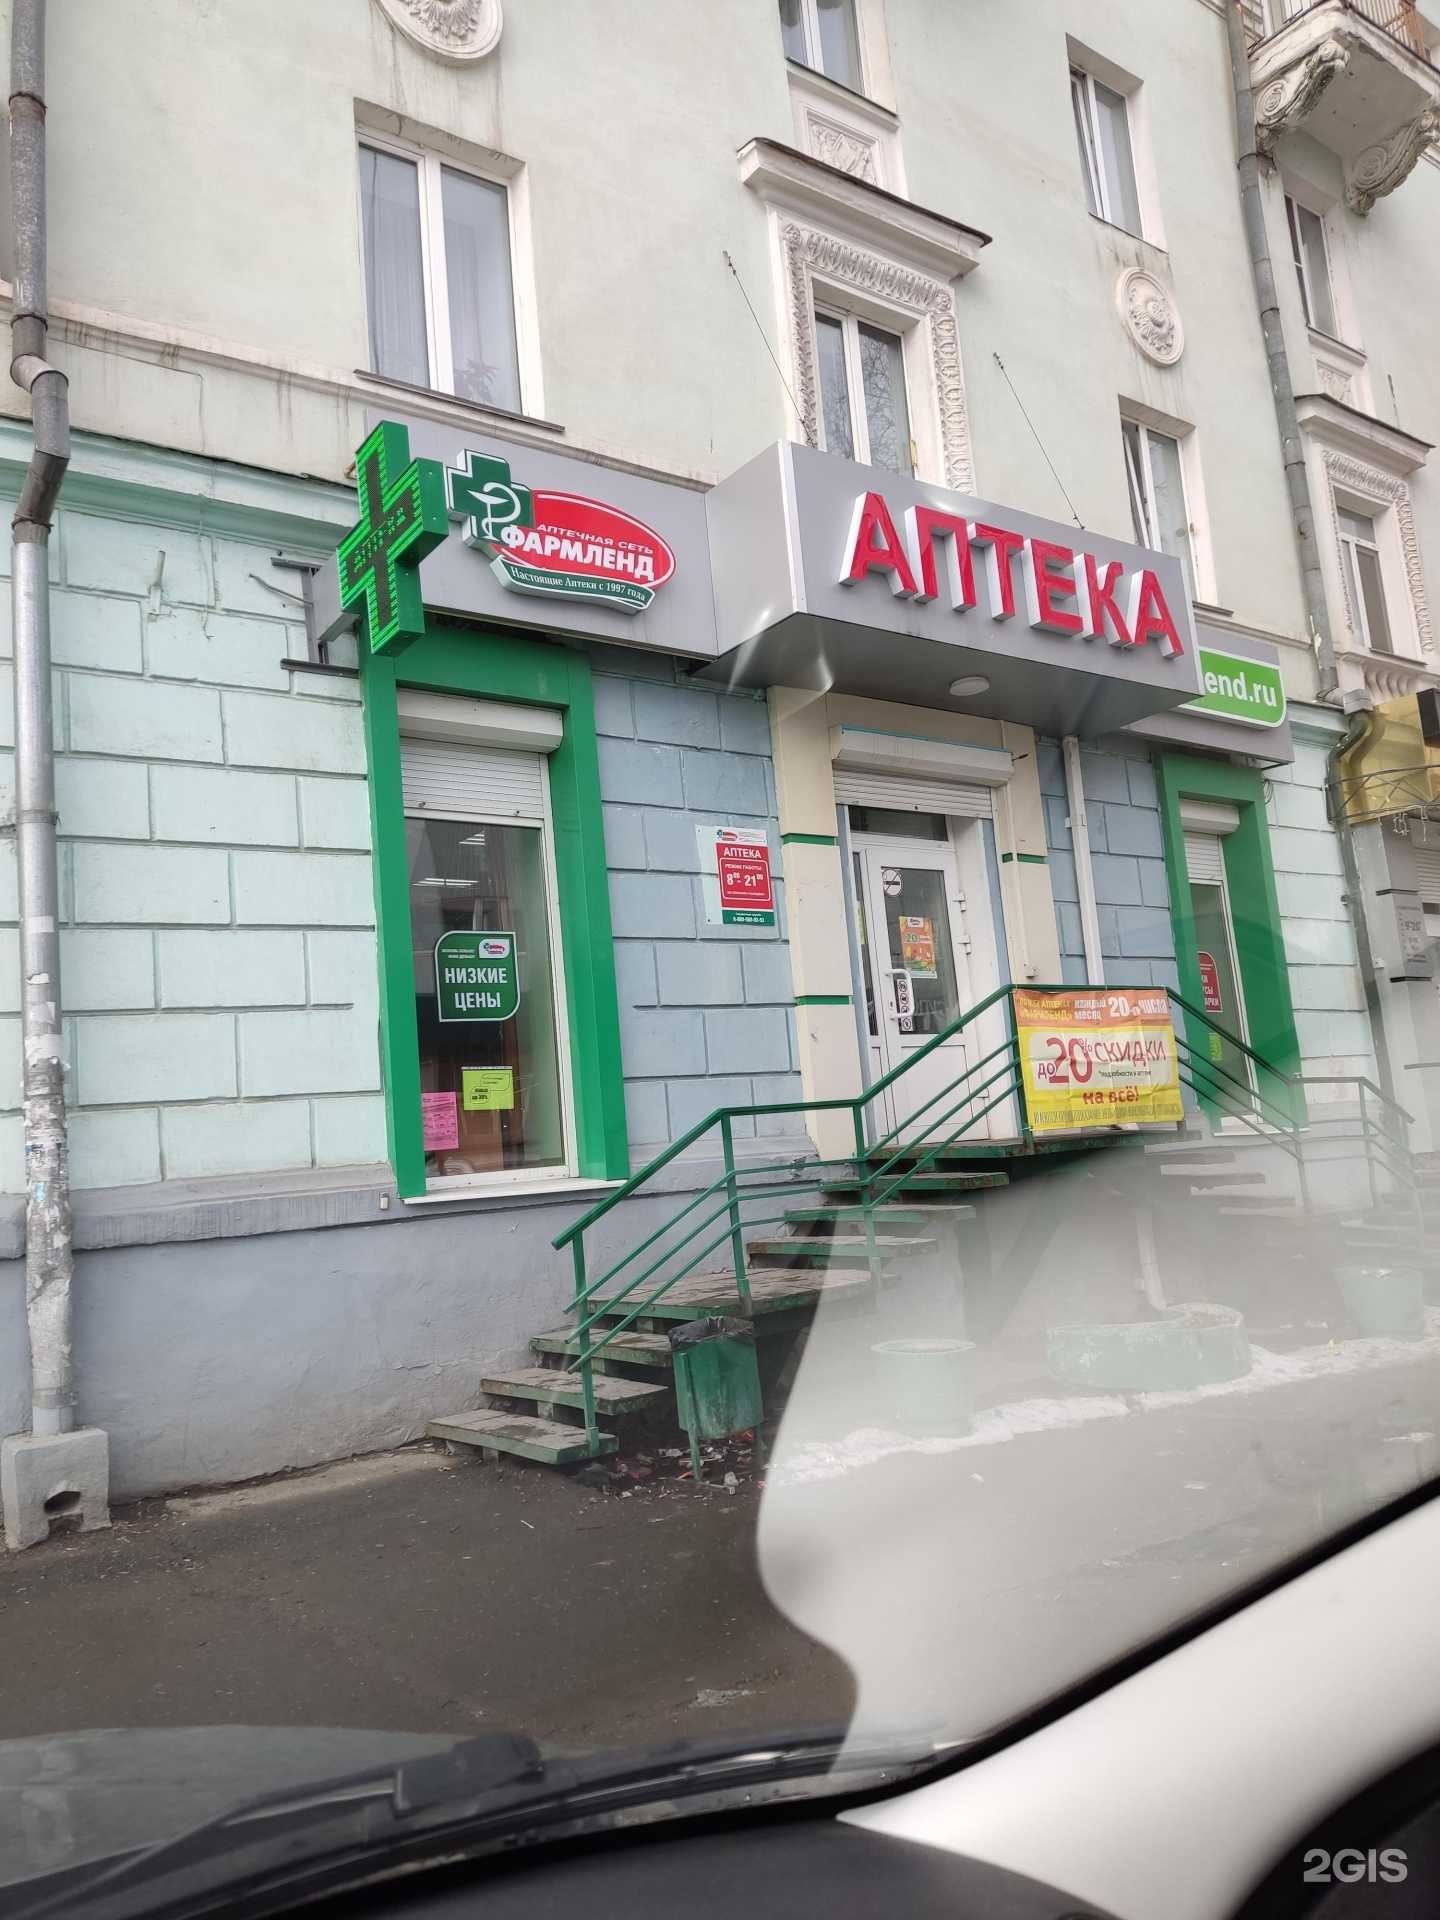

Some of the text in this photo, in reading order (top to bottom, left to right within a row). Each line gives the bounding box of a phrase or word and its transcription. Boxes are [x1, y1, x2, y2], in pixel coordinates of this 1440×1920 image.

[537, 523, 654, 554] АПТЕЧНАЯ СЕТЬ
[500, 524, 655, 581] ФАРМЛЕНД
[510, 566, 563, 586] Настоящие
[564, 578, 597, 590] Аптеки
[607, 582, 626, 593] 1997
[627, 589, 646, 601] года
[839, 491, 1184, 659] АПТЕКА
[723, 847, 762, 859] АПТЕКА
[444, 967, 508, 984] НИЗКИЕ
[454, 992, 502, 1012] ЦЕНЫ
[1094, 1040, 1167, 1067] СКИДКИ
[1082, 1085, 1140, 1105] на всё!
